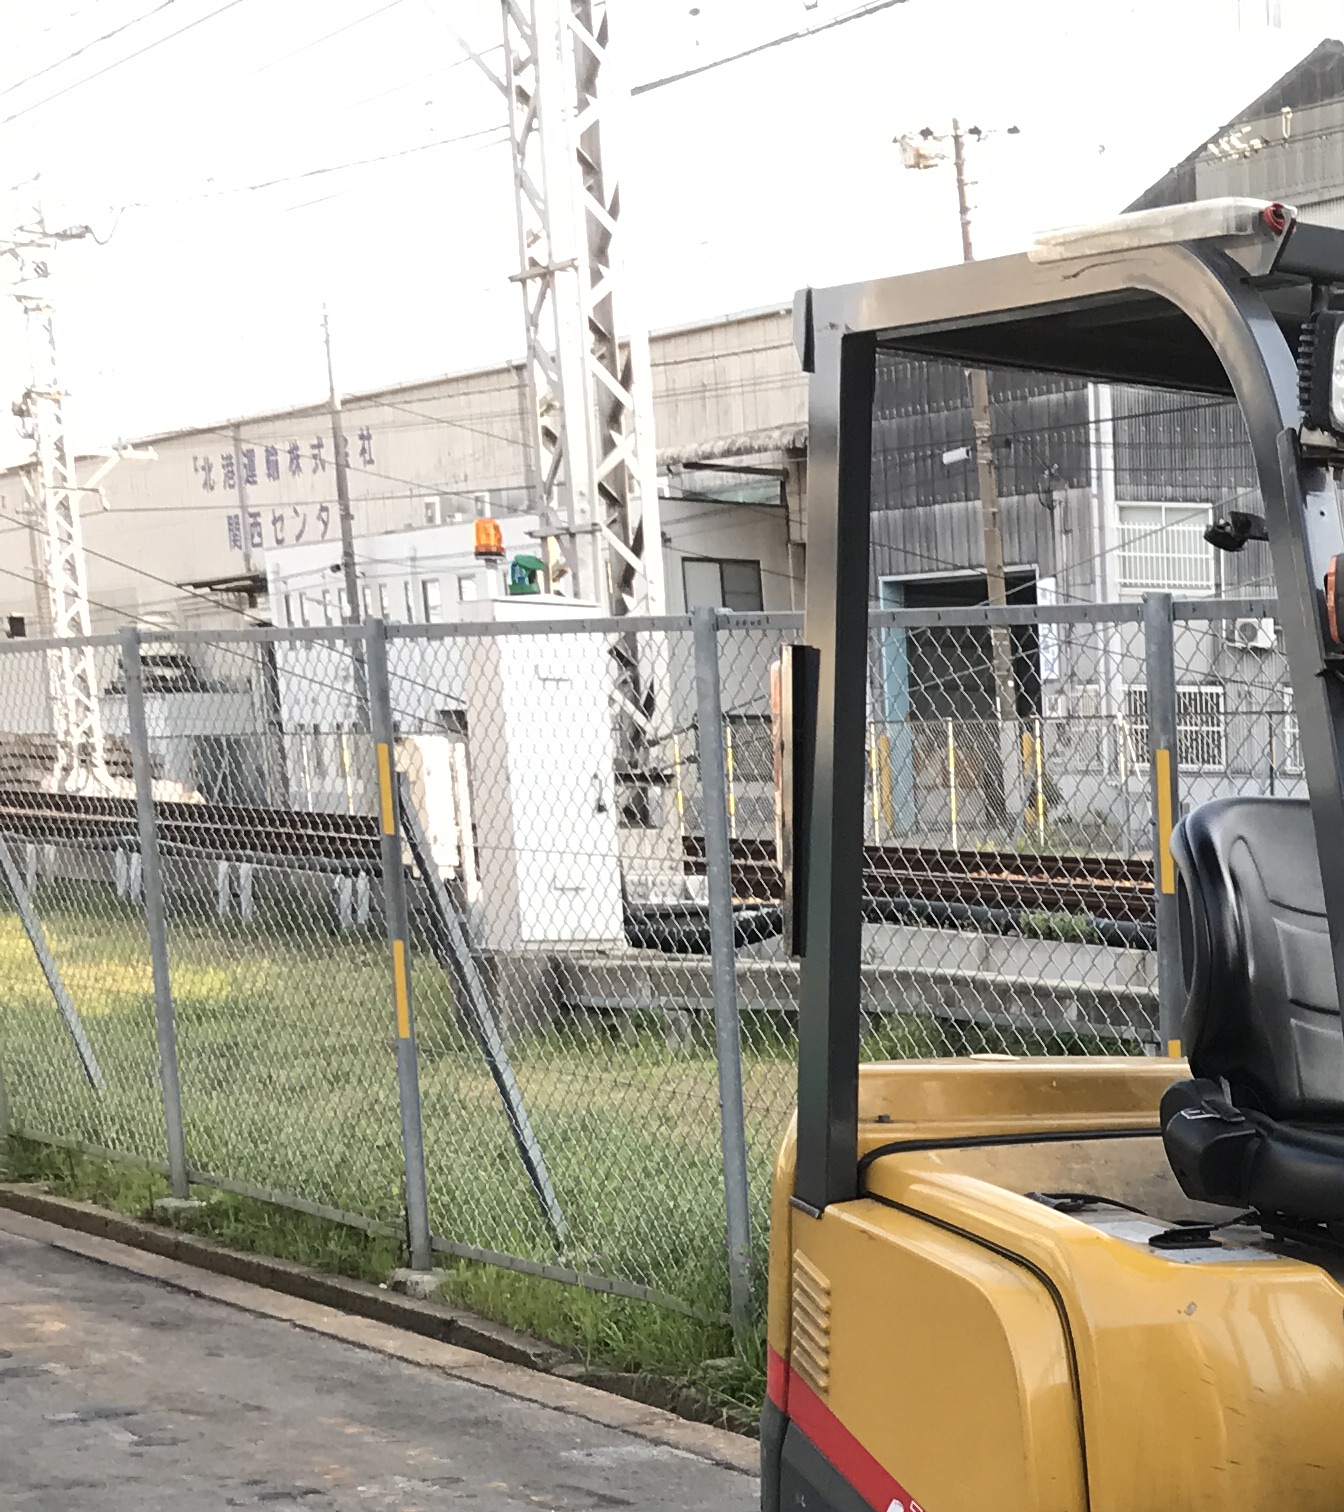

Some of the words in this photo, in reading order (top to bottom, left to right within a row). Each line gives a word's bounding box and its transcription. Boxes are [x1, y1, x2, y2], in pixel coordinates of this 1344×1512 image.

[227, 503, 355, 551] 関西センタ
